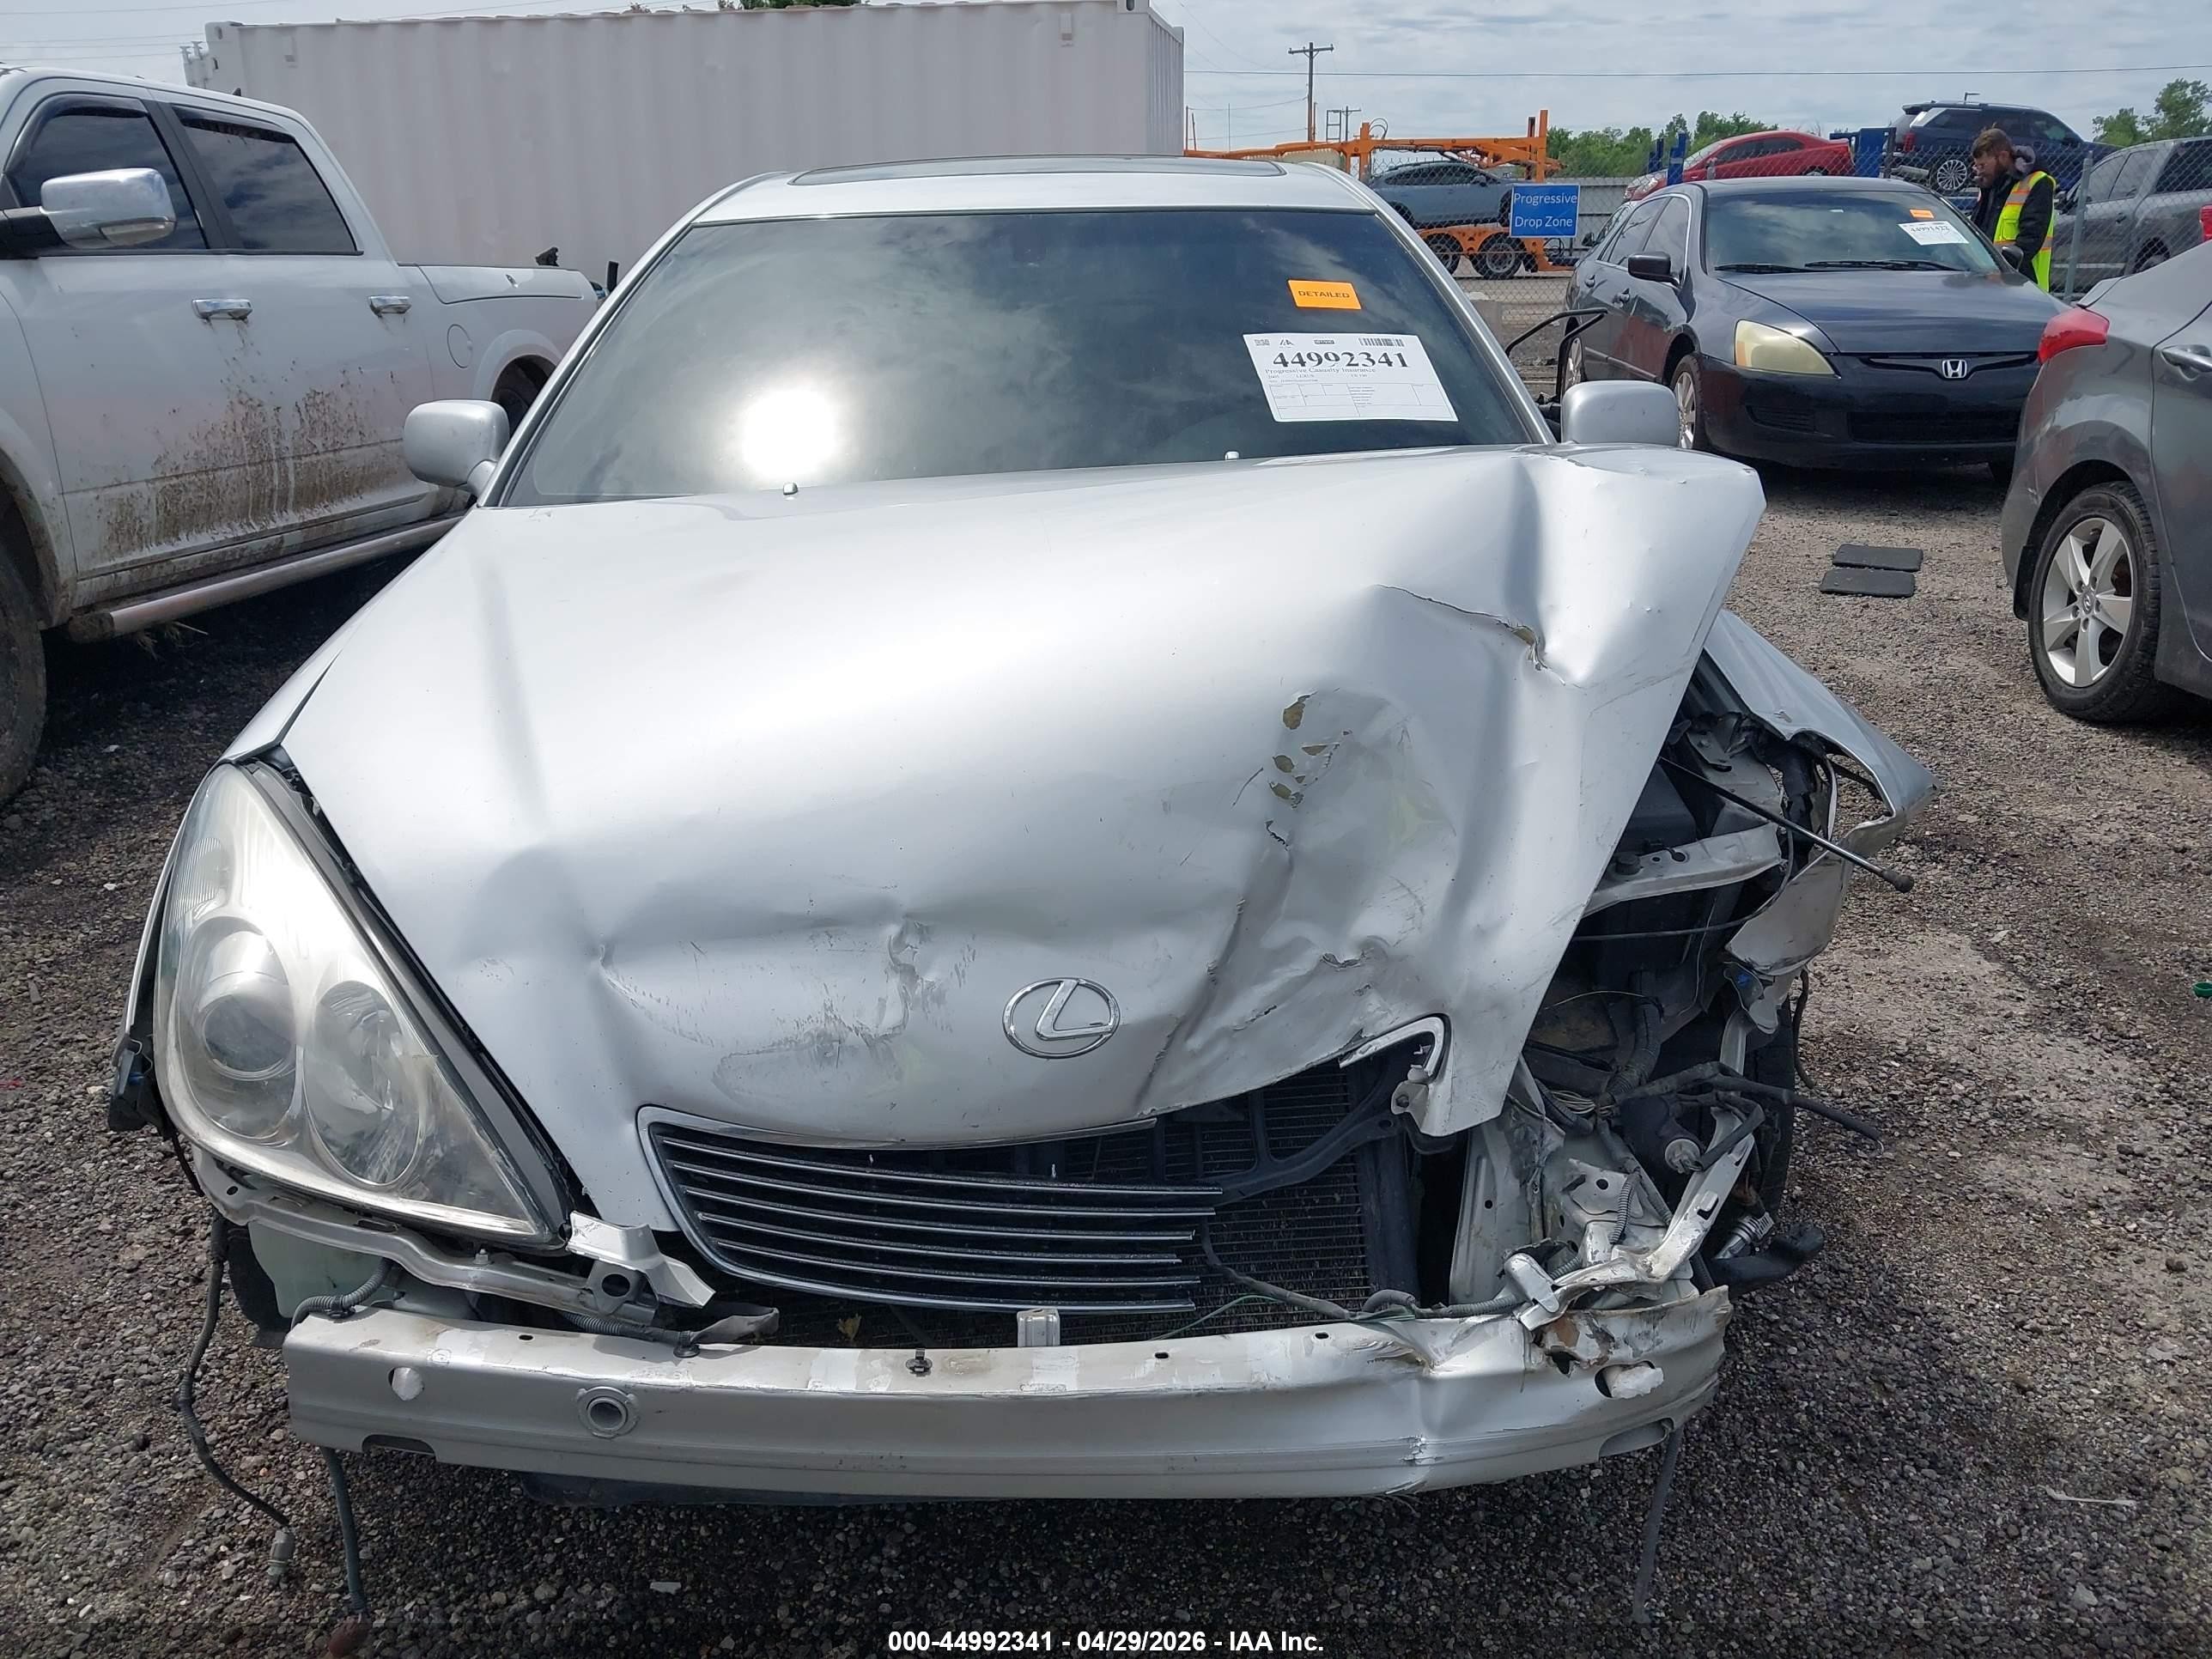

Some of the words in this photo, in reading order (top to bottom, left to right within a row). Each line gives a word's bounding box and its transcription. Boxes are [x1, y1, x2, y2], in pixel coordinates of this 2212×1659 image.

[1514, 192, 1577, 206] Progressive
[1515, 216, 1543, 229] Drop
[1545, 216, 1573, 227] Zone
[1273, 351, 1410, 368] 44992341
